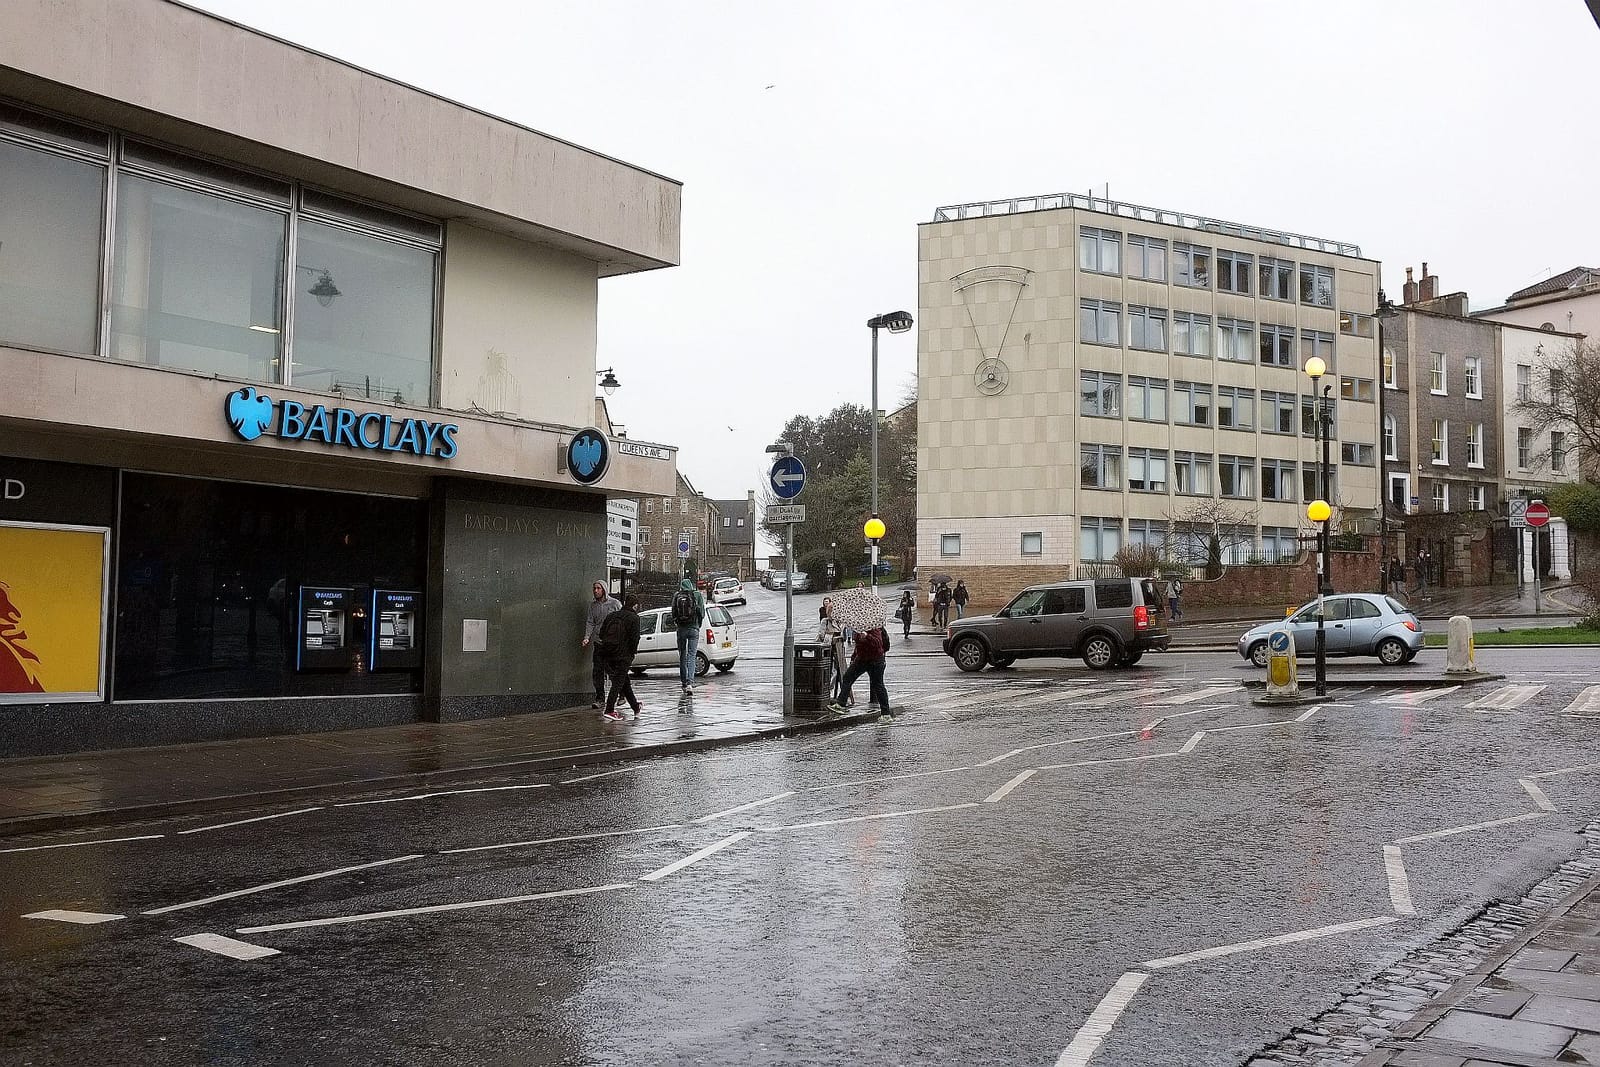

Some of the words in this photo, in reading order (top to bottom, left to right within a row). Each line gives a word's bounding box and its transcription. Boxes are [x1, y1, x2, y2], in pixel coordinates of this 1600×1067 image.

[279, 400, 459, 459] BARCLAYS
[464, 513, 539, 535] BARCLAYS
[556, 521, 591, 539] BANK
